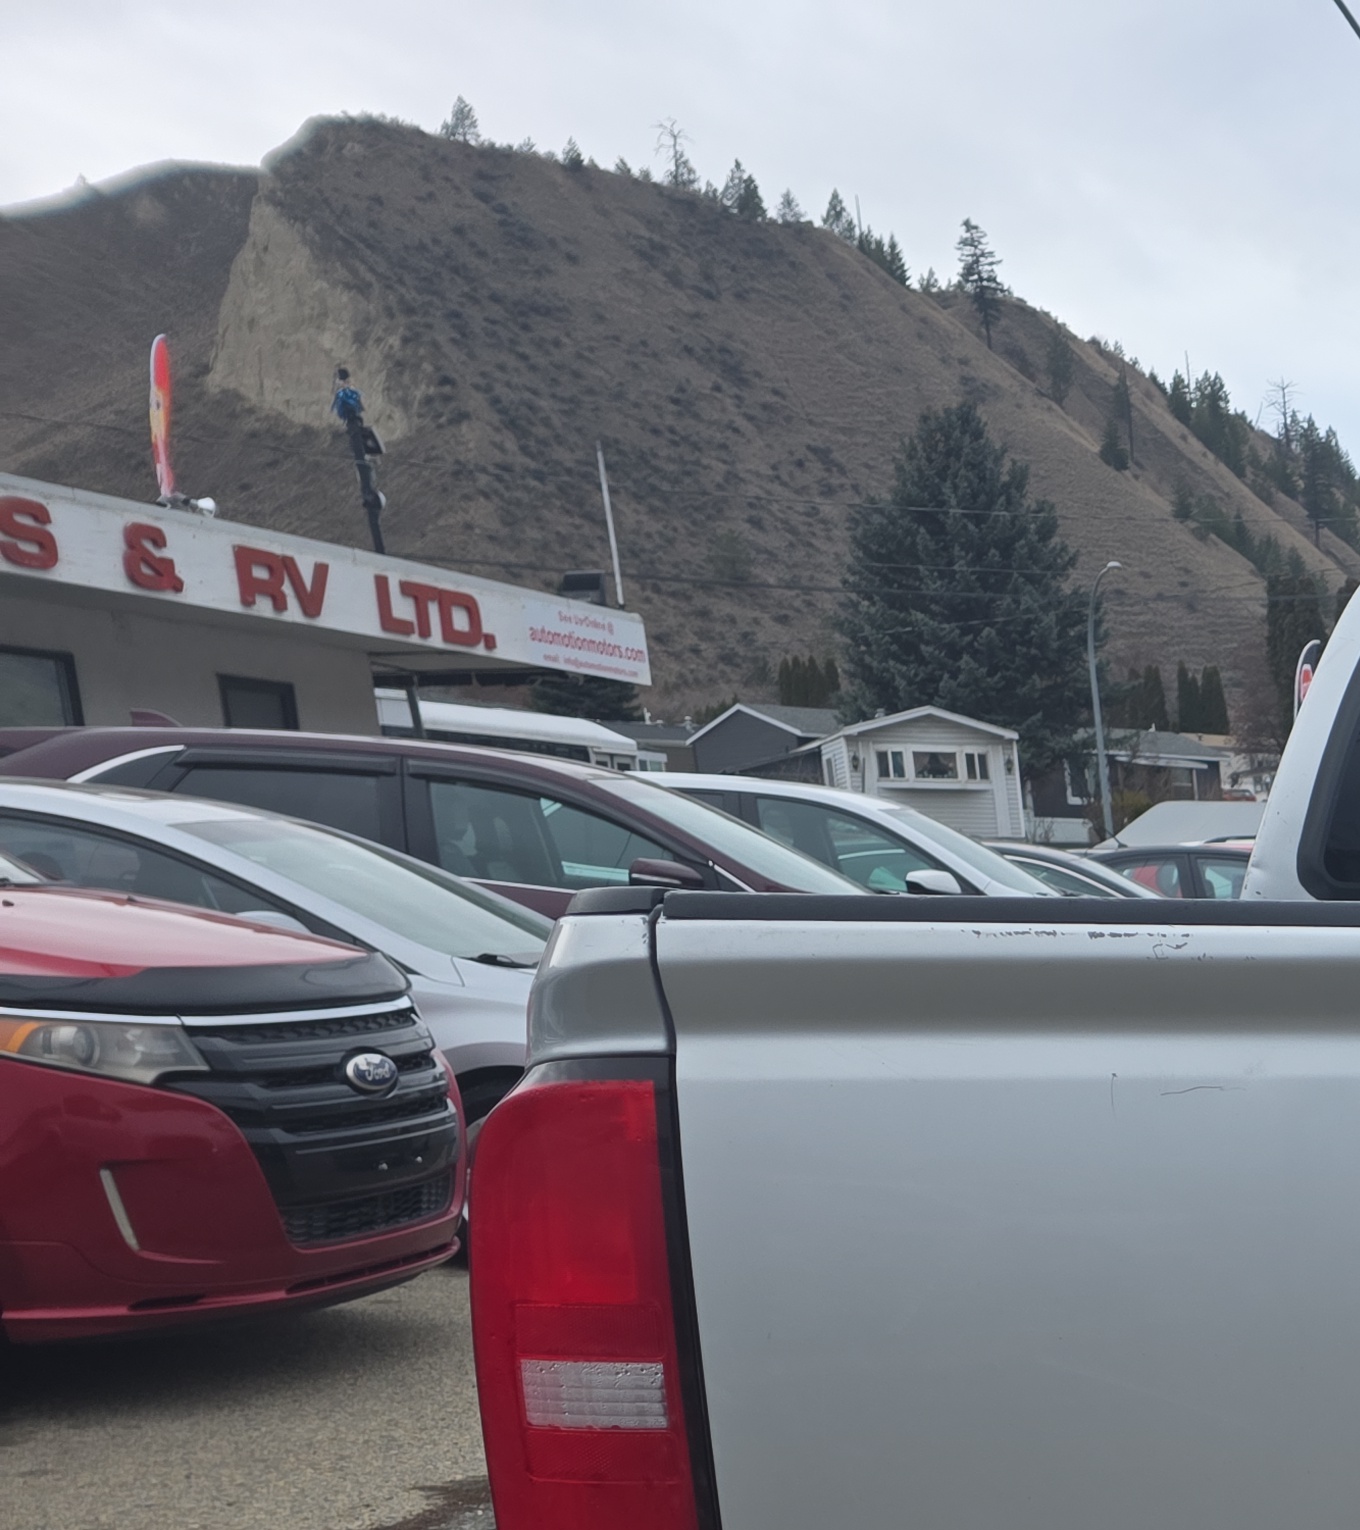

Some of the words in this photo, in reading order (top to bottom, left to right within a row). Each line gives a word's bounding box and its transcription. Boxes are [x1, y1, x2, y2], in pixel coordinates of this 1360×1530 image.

[0, 495, 58, 570] S
[122, 521, 184, 593] &
[232, 544, 330, 619] RV
[373, 573, 497, 652] LTD.
[529, 626, 647, 664] automotionmotors.com
